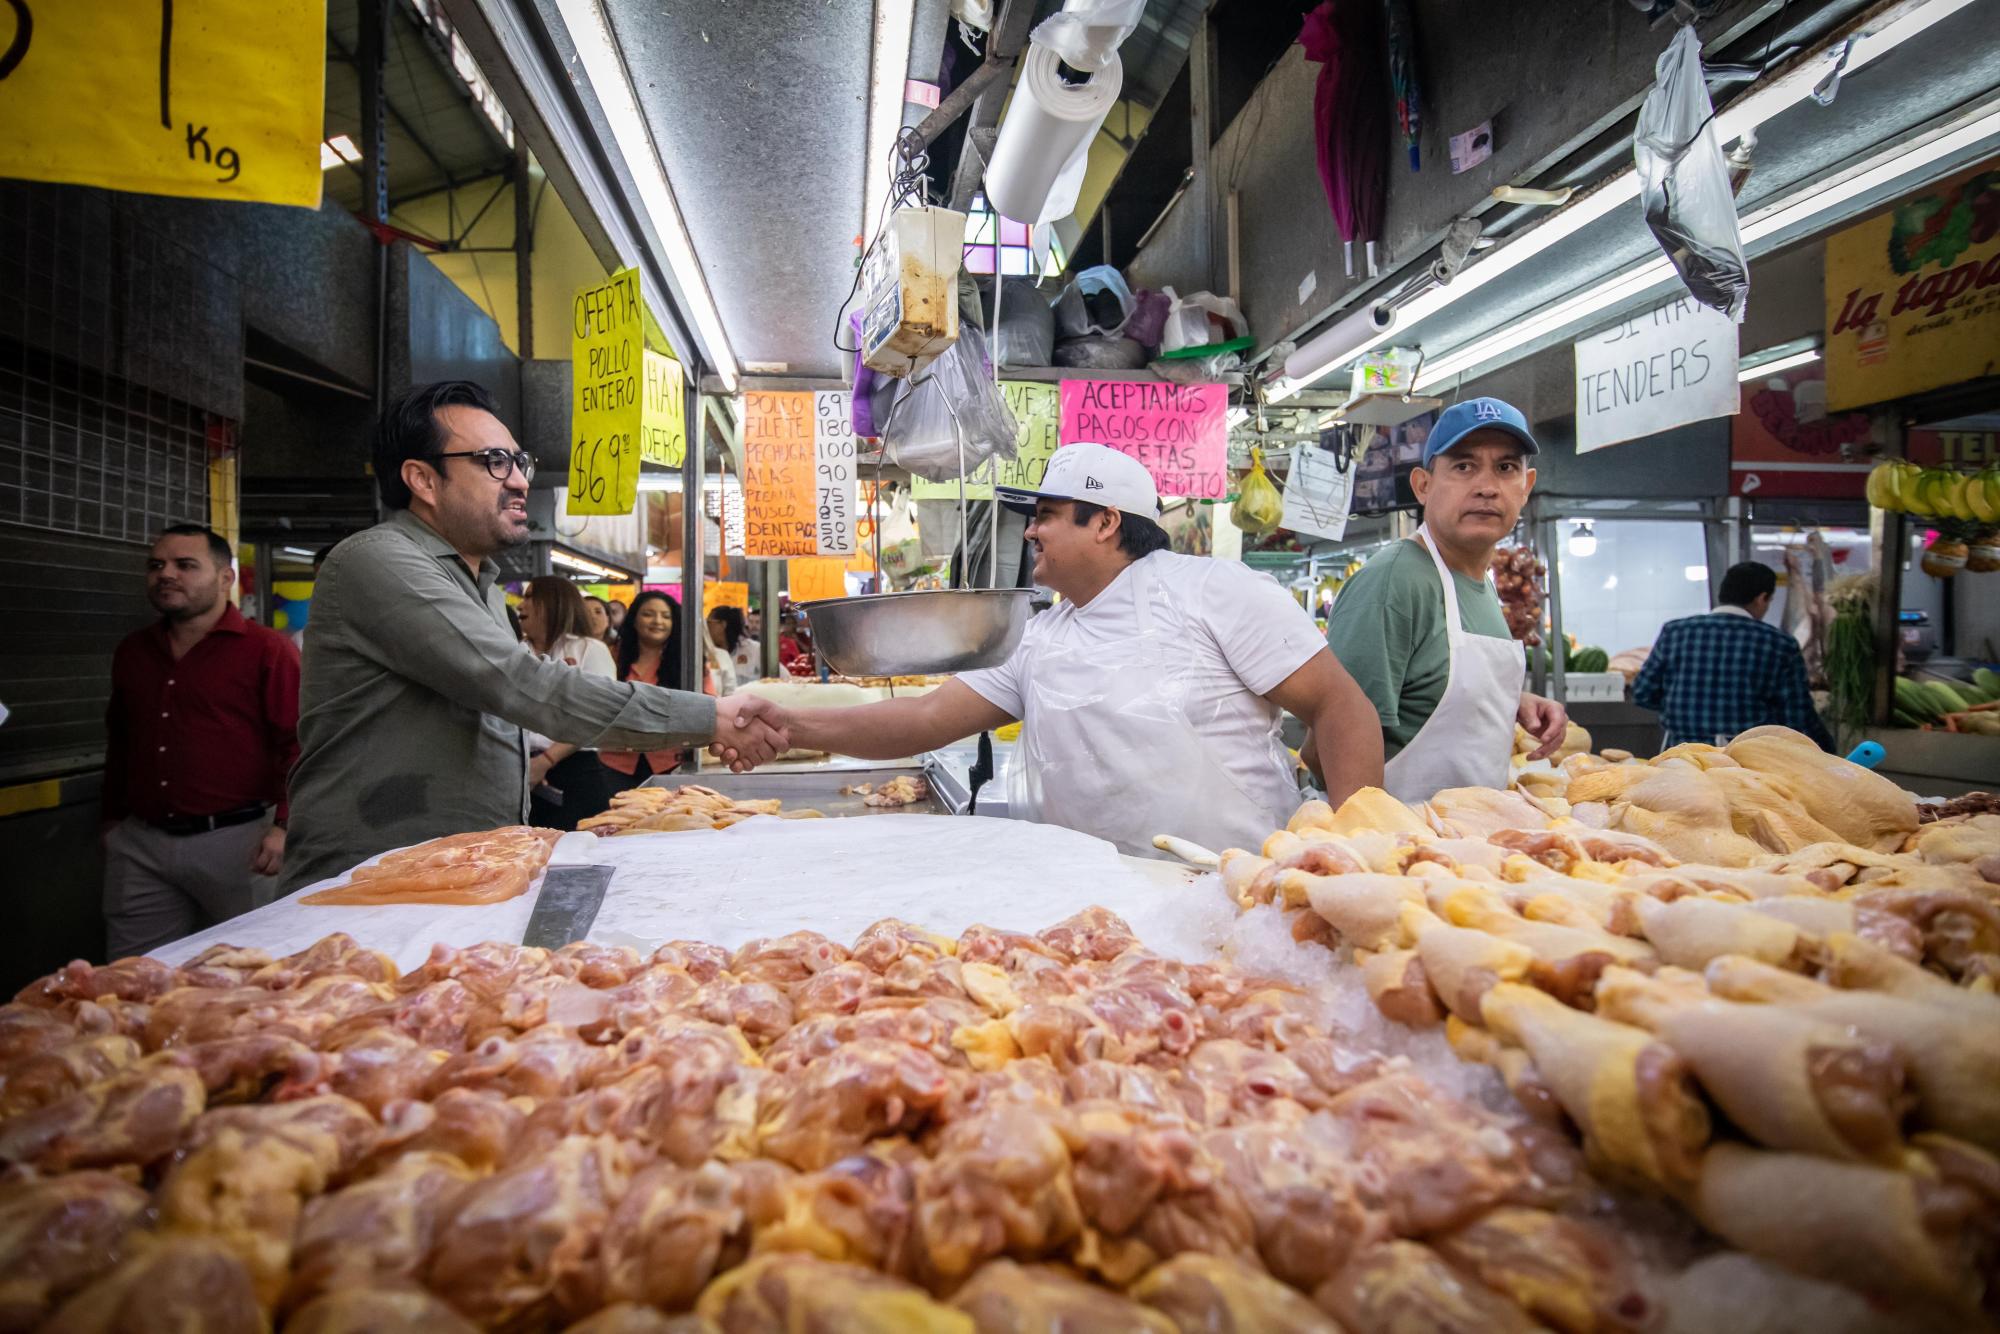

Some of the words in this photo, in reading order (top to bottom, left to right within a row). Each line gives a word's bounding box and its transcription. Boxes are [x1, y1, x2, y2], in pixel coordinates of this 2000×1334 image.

[185, 122, 241, 183] Kg
[574, 276, 640, 339] OFERTA
[1832, 287, 1885, 336] la
[588, 338, 631, 379] POLLO
[647, 359, 682, 420] HAY
[1582, 338, 1711, 416] TENDERS
[582, 376, 637, 413] ENTERO
[745, 392, 804, 416] POLLO
[818, 393, 843, 418] 69
[1081, 381, 1208, 414] ACEPTAMOS
[745, 416, 809, 439] FILETE
[820, 418, 853, 438] 180
[1077, 412, 1149, 442] PAGOS
[1154, 417, 1198, 444] CON
[641, 425, 682, 466] DERS
[819, 441, 854, 460] 100
[745, 466, 795, 486] ALAS
[818, 464, 847, 482] 90
[819, 488, 845, 505] 75
[746, 505, 796, 521] MUSLO
[818, 505, 846, 520] 85
[820, 521, 847, 536] 50
[821, 536, 849, 551] 25
